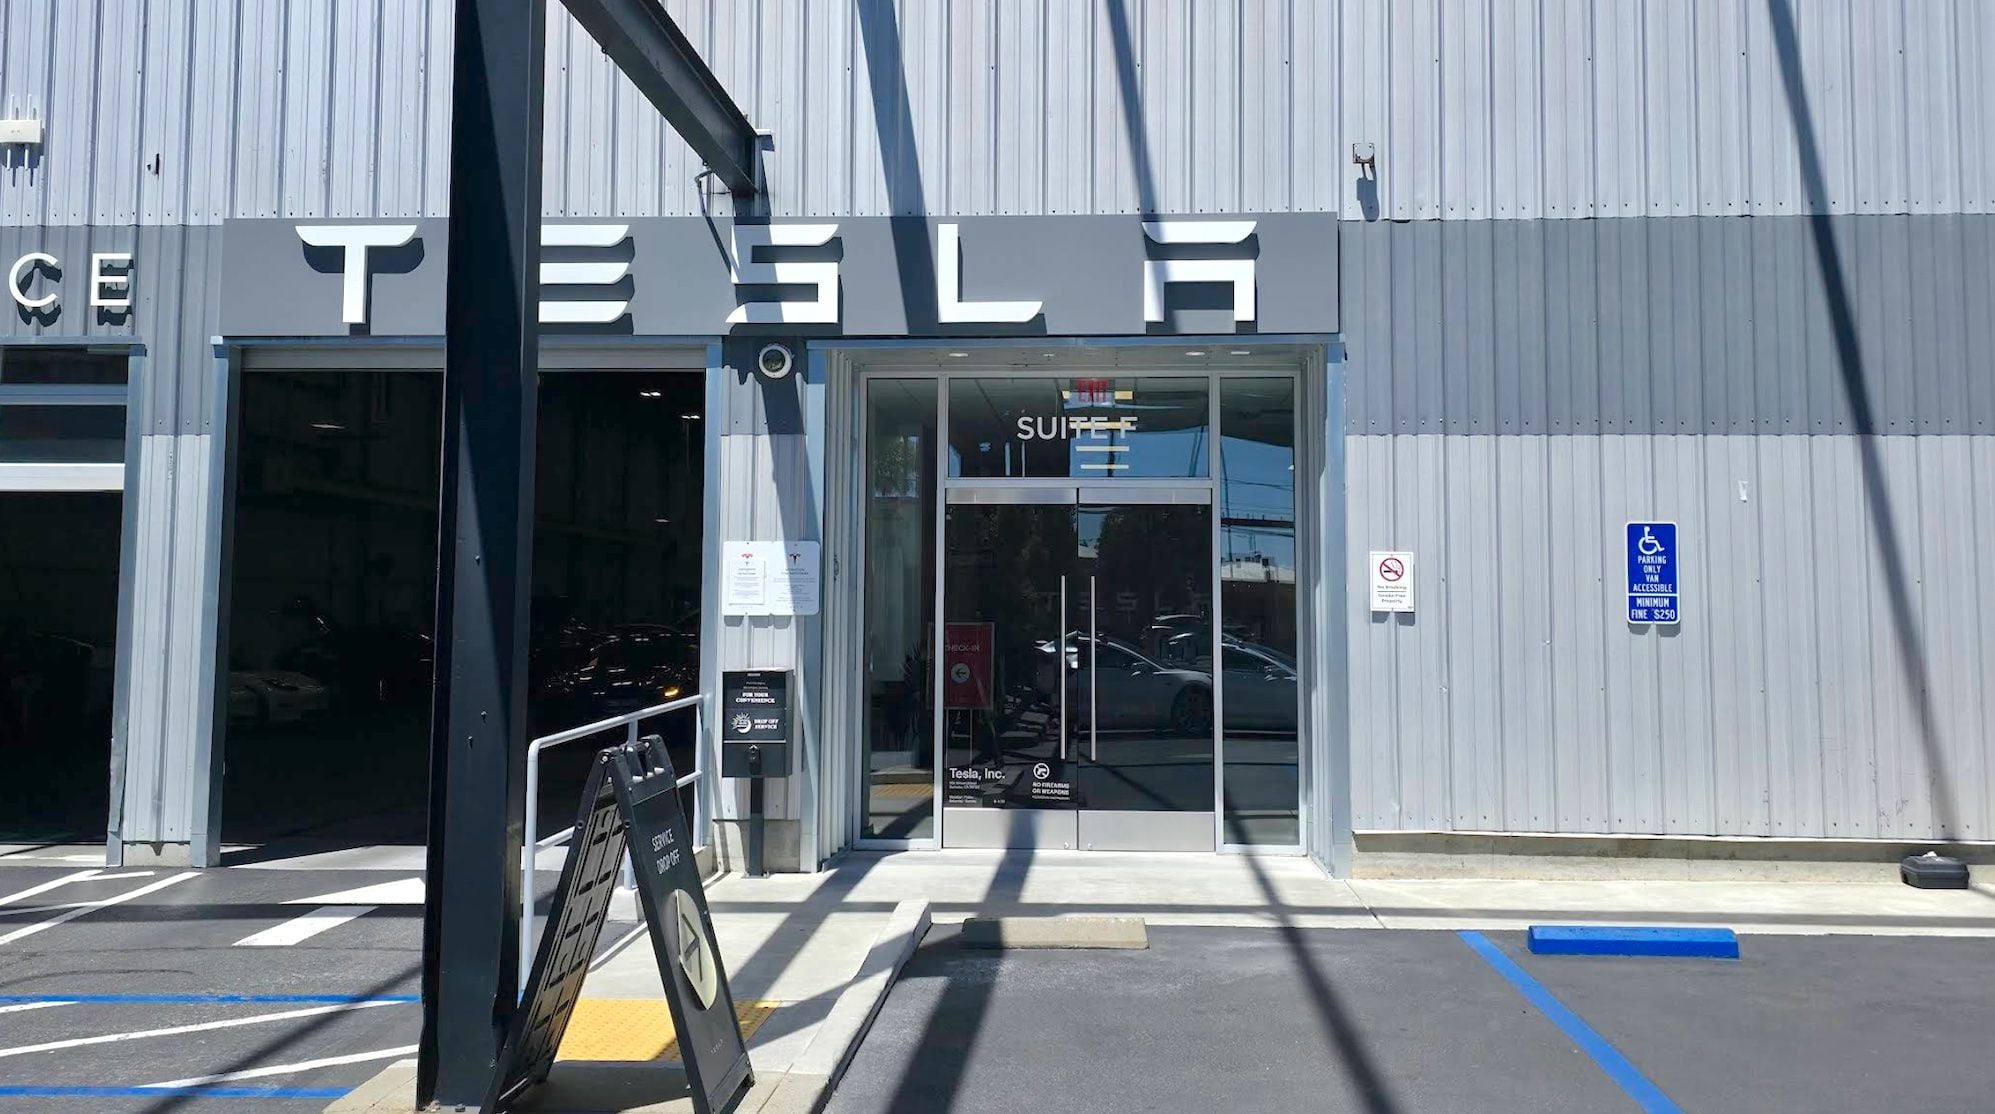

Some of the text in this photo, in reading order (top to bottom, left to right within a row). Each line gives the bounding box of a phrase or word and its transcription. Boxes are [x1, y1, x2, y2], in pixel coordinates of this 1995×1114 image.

[294, 220, 1257, 323] TESLA
[9, 252, 132, 306] CE
[1077, 379, 1109, 402] EXIT
[1017, 416, 1138, 440] SUITE F
[1637, 555, 1667, 565] PARKING
[1643, 565, 1661, 573] ONLY
[1645, 574, 1659, 583] VAN
[1632, 583, 1673, 592] ACCESSIBLE
[1636, 597, 1670, 607] MINIMUM
[1631, 609, 1648, 619] FINE
[949, 767, 1006, 780] Tesla, Inc.
[652, 828, 674, 852] SERVICE
[656, 848, 680, 875] DROP OFF
